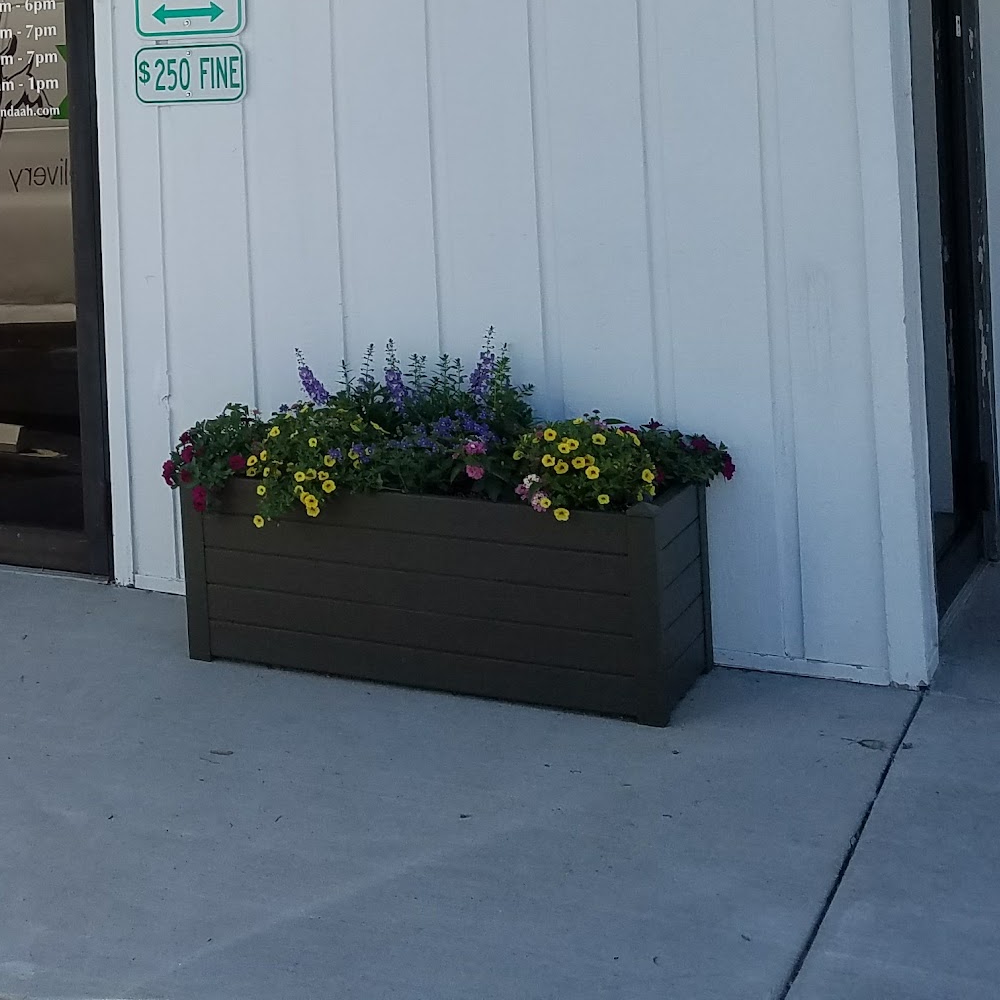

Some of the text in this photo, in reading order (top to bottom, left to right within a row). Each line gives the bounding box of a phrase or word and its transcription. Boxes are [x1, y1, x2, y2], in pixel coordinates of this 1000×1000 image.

[25, 24, 58, 39] 7pm
[26, 50, 58, 66] 7pm
[138, 55, 240, 91] $250 FINE
[28, 76, 60, 92] 1pm
